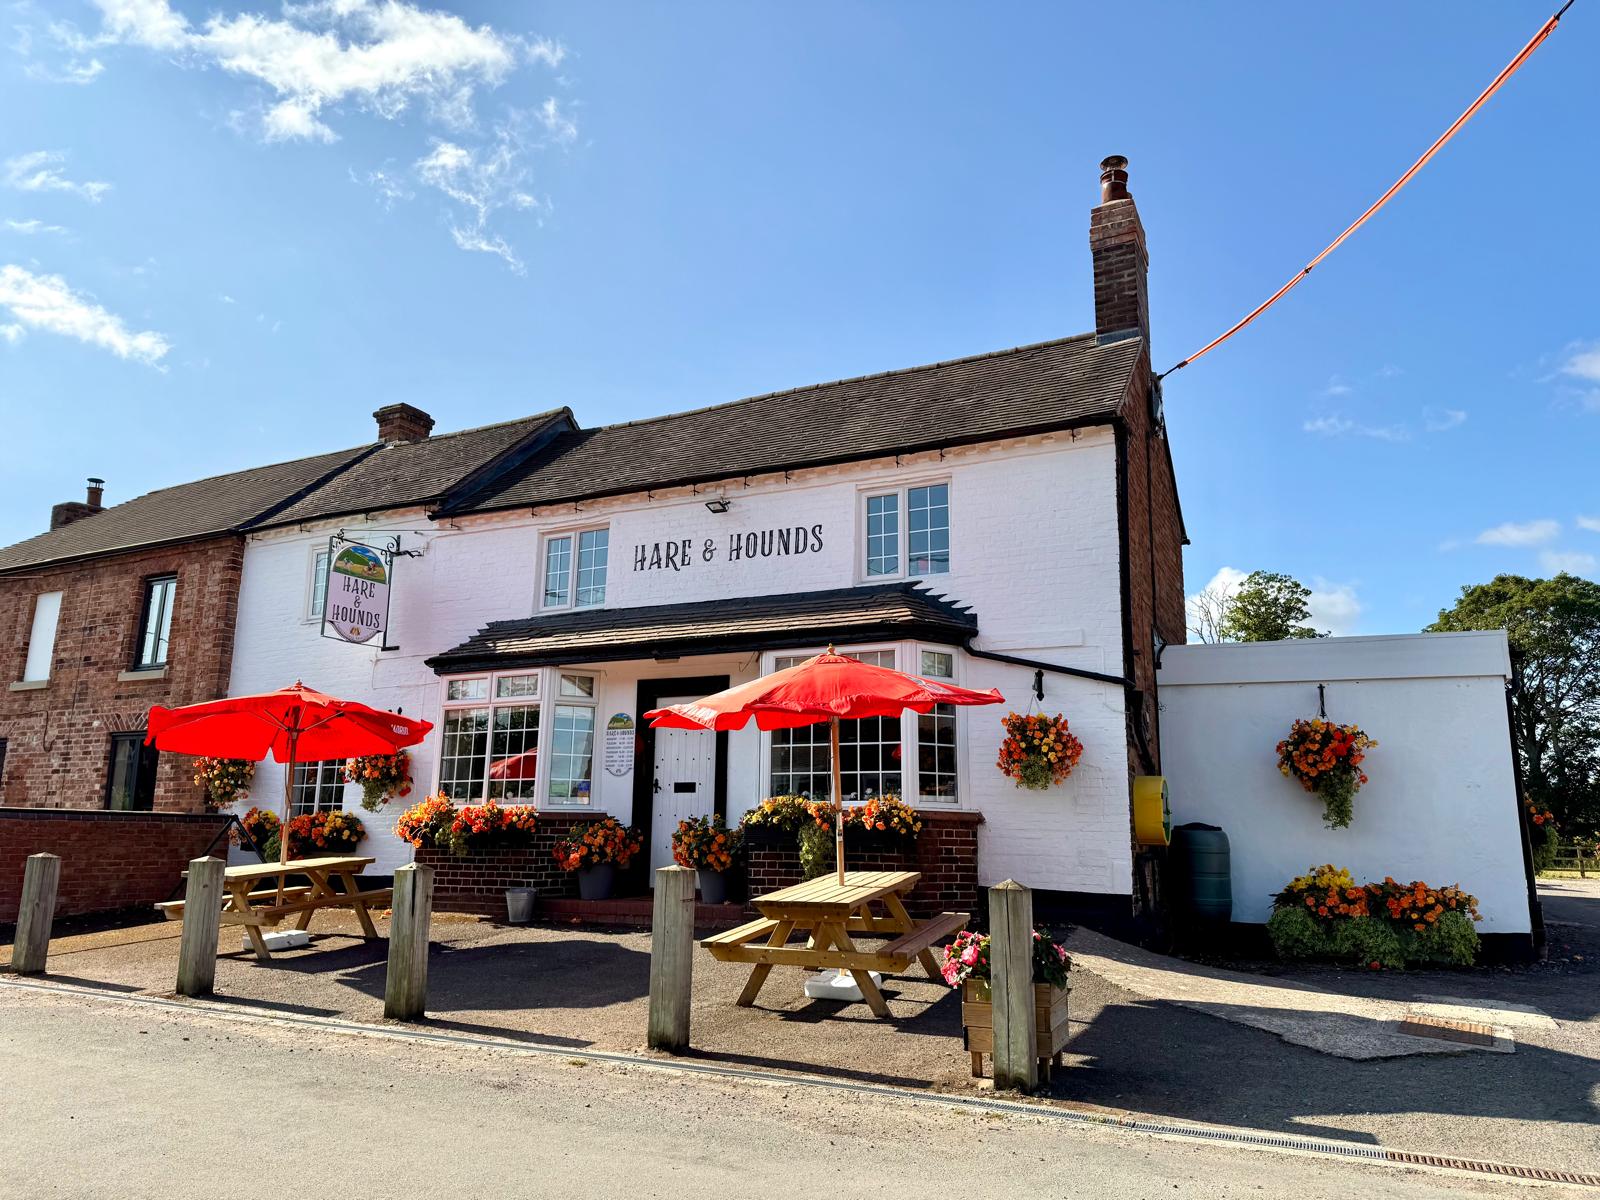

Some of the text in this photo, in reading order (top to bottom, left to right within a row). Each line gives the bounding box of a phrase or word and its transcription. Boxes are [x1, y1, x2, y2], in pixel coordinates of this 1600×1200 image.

[633, 524, 824, 572] HARE & HOUNDS
[343, 576, 376, 599] HARE
[353, 595, 362, 608] &
[332, 604, 381, 629] HOUNDS
